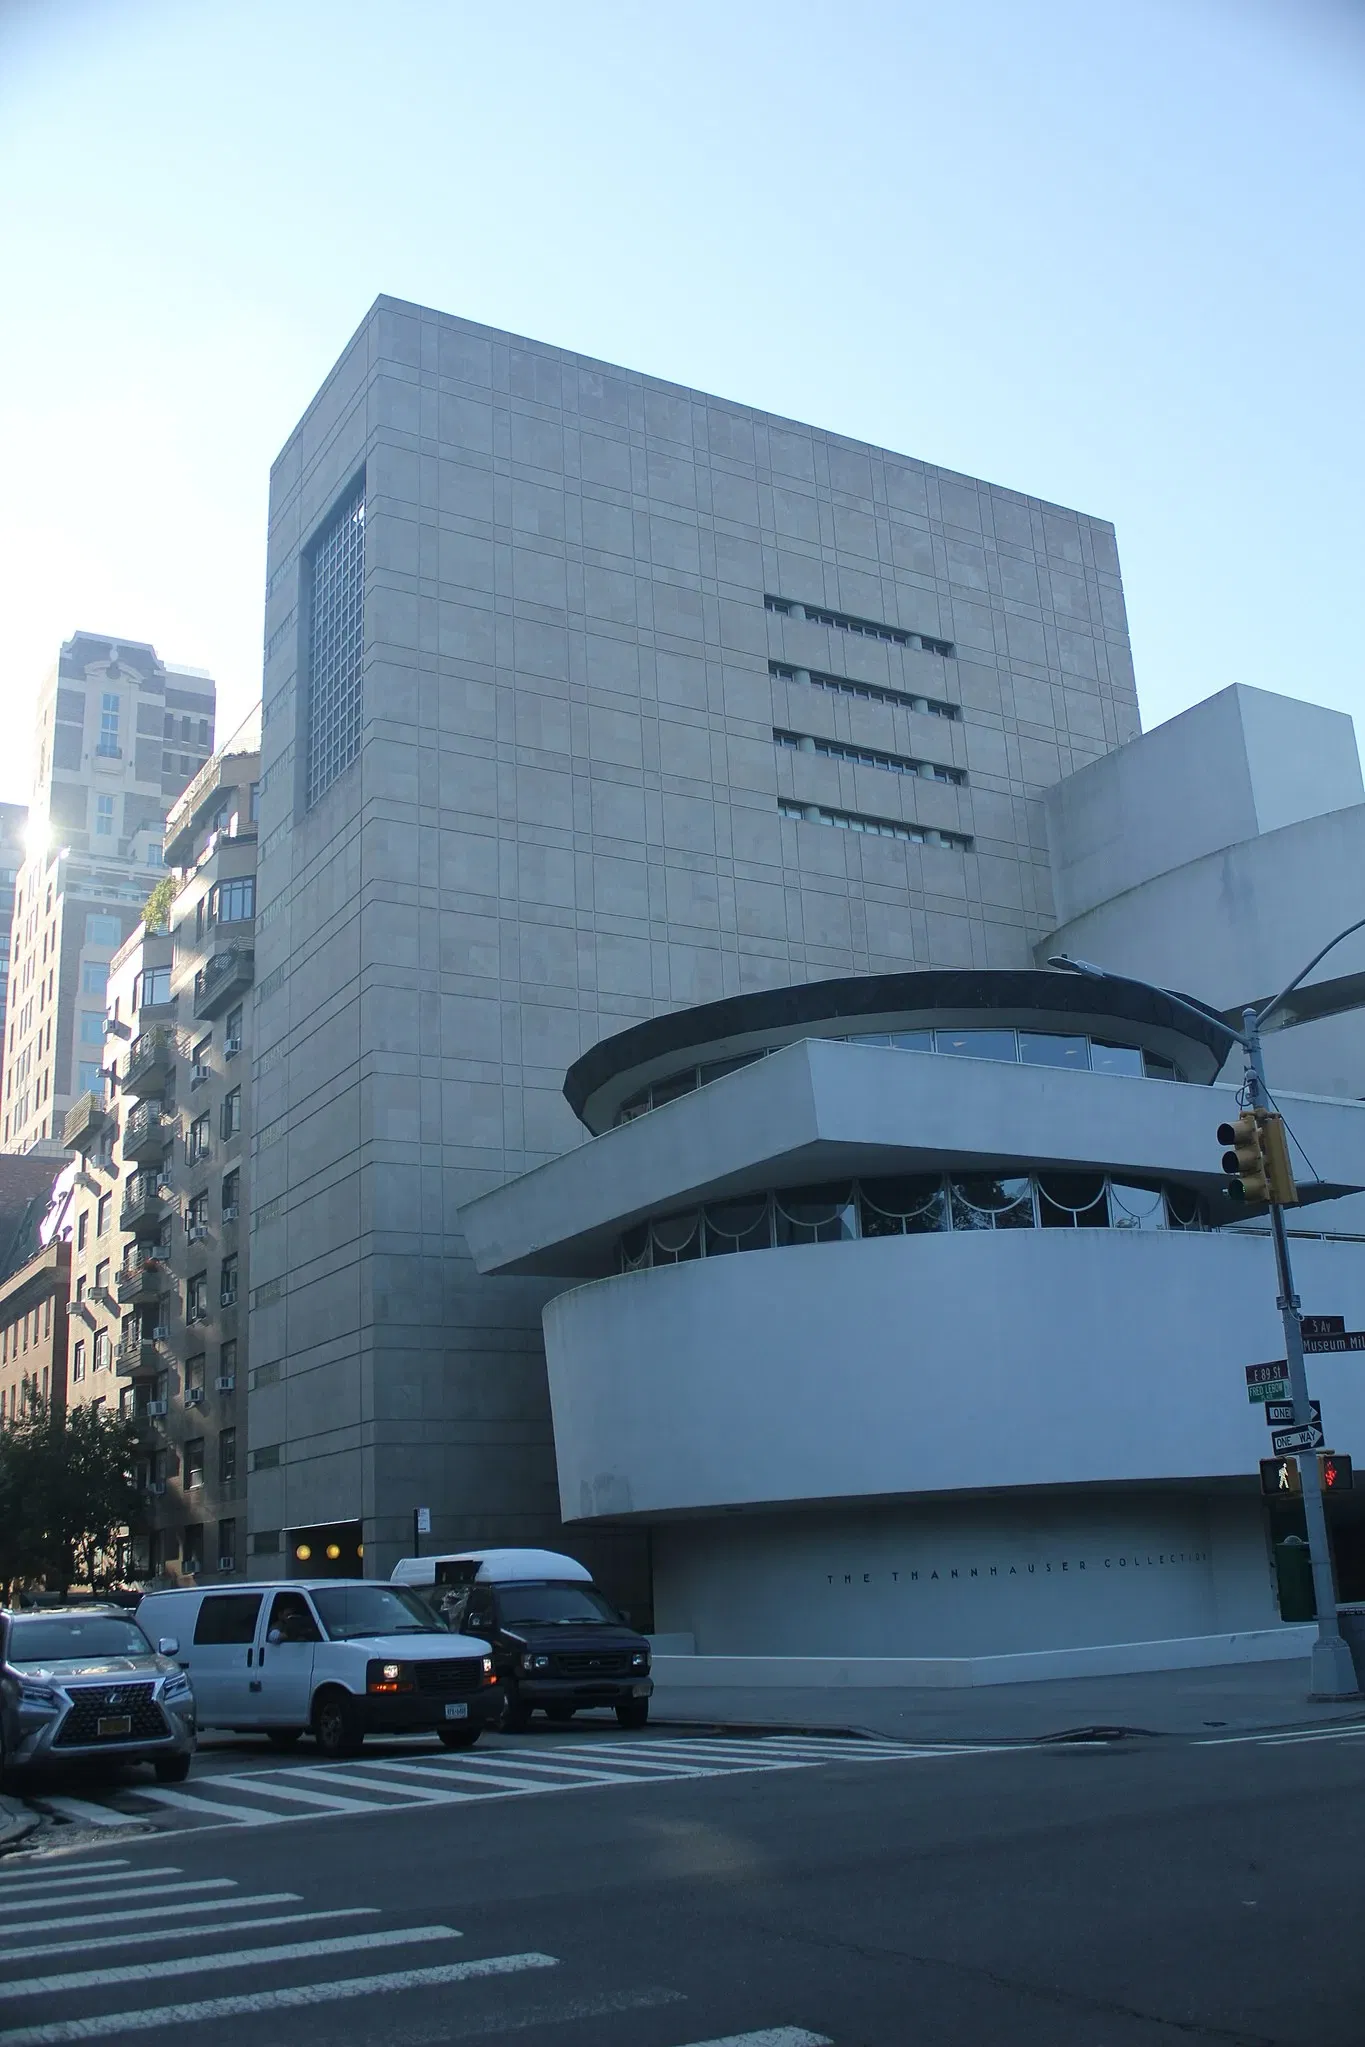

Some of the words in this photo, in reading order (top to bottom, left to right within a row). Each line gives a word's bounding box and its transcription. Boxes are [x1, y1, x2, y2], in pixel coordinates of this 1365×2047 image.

[1312, 1319, 1318, 1333] 5
[1321, 1320, 1331, 1333] Av
[1303, 1339, 1346, 1352] Museum
[1254, 1369, 1259, 1382] E
[1261, 1367, 1271, 1380] 89
[1273, 1365, 1282, 1379] St
[1249, 1385, 1264, 1397] FRED
[1265, 1381, 1283, 1394] LEBOW
[1273, 1408, 1291, 1418] ONE
[1276, 1435, 1293, 1448] ONE
[1299, 1430, 1316, 1443] WAY
[827, 1573, 871, 1585] THE
[892, 1560, 1086, 1582] THANNHAUSER
